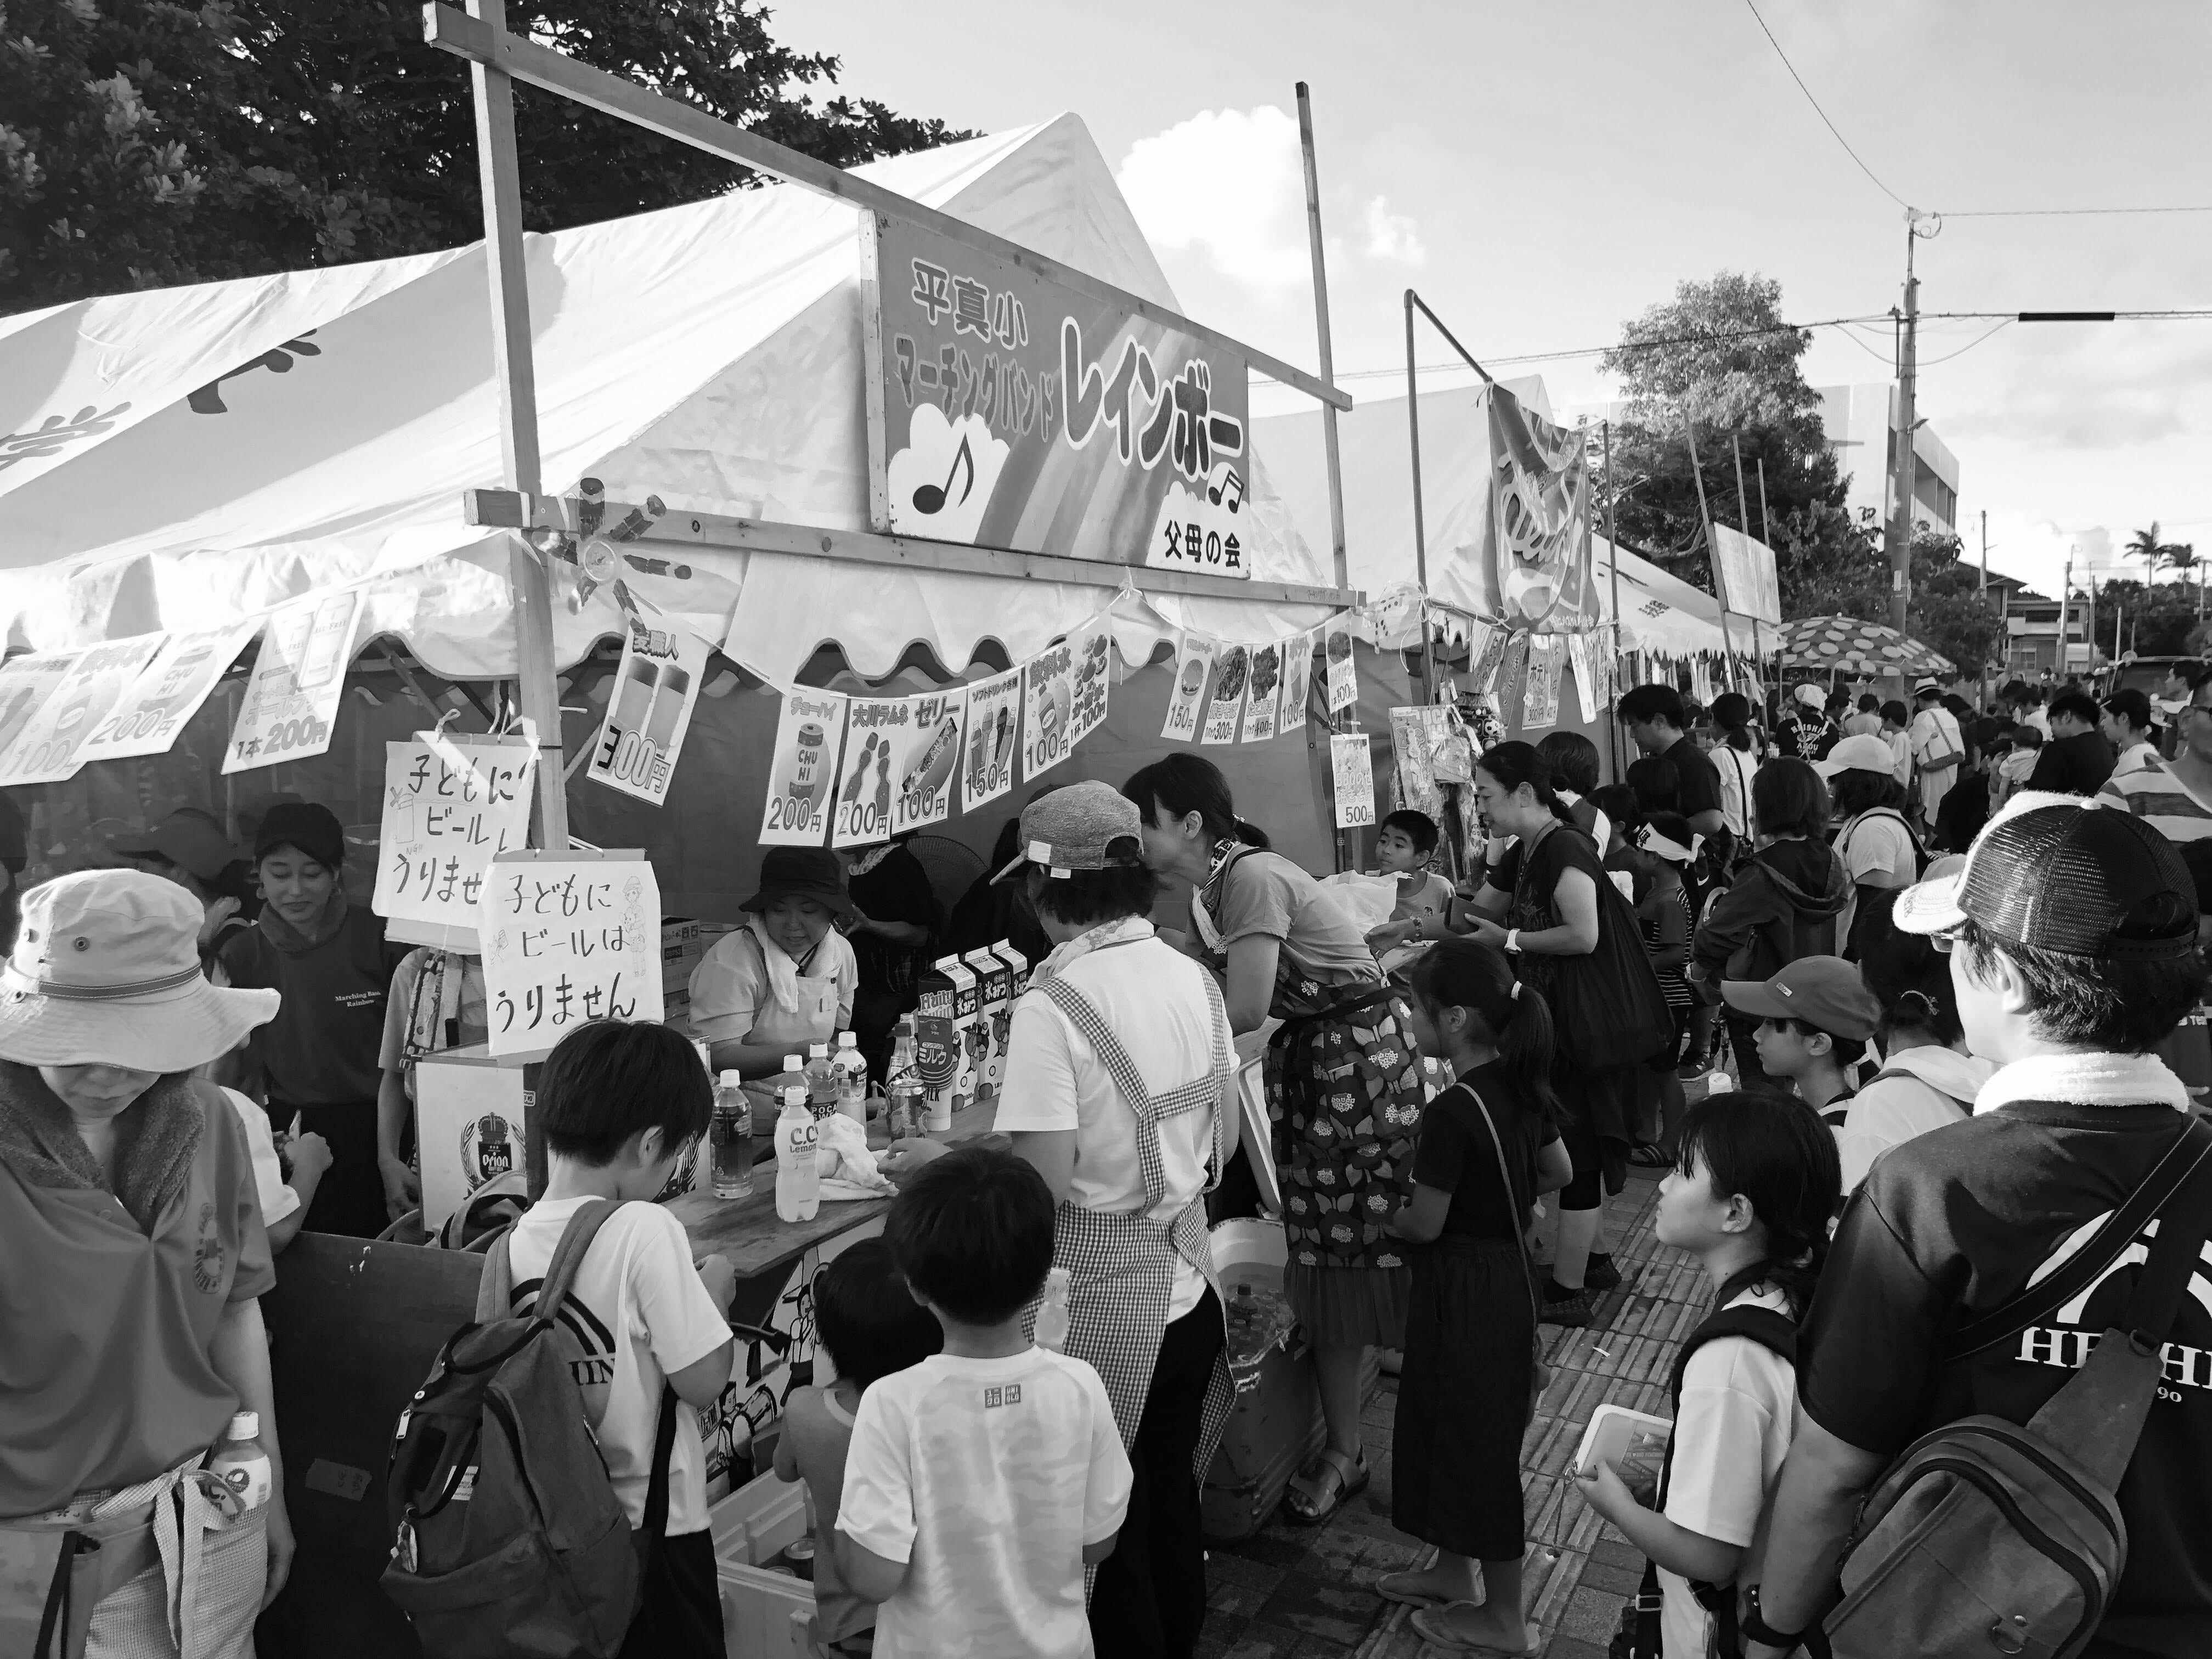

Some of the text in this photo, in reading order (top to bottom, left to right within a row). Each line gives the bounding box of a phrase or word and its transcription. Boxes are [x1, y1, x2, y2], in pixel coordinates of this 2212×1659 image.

[911, 256, 1029, 351] 平真小
[893, 332, 1054, 443] マーチングバンド
[1060, 315, 1244, 482] レインボー
[1164, 519, 1240, 568] 父母の会
[1029, 647, 1073, 690] 飲料水
[972, 675, 1019, 703] ソフトドリンク各種
[852, 704, 909, 728] 大川ラムネ
[915, 696, 960, 729] ゼリー
[1169, 703, 1194, 731] 150円
[1209, 703, 1238, 719] 焼きそば
[1246, 699, 1275, 717] たこ焼き
[1283, 701, 1304, 730] 100円
[88, 708, 177, 745] 200円
[597, 724, 671, 794] 300円
[798, 750, 818, 765] CHU
[1025, 731, 1069, 774] 100円
[408, 755, 514, 803] 子どもに
[798, 768, 810, 781] HI
[965, 763, 1009, 803] 150円
[768, 795, 821, 833] 200円
[837, 799, 888, 837] 200円
[896, 785, 947, 826] 100円
[1346, 805, 1374, 823] 500円
[505, 874, 611, 917] 子どもに
[522, 925, 631, 957] ビールは
[335, 992, 367, 1002] Marching
[347, 997, 375, 1008] Rainbow
[495, 972, 635, 1032] うりません
[919, 989, 954, 1010] Fruity
[957, 997, 976, 1015] 氷みつ
[985, 981, 1006, 1001] 氷みつ
[919, 1047, 946, 1065] ミルク
[789, 1143, 817, 1153] Lemon
